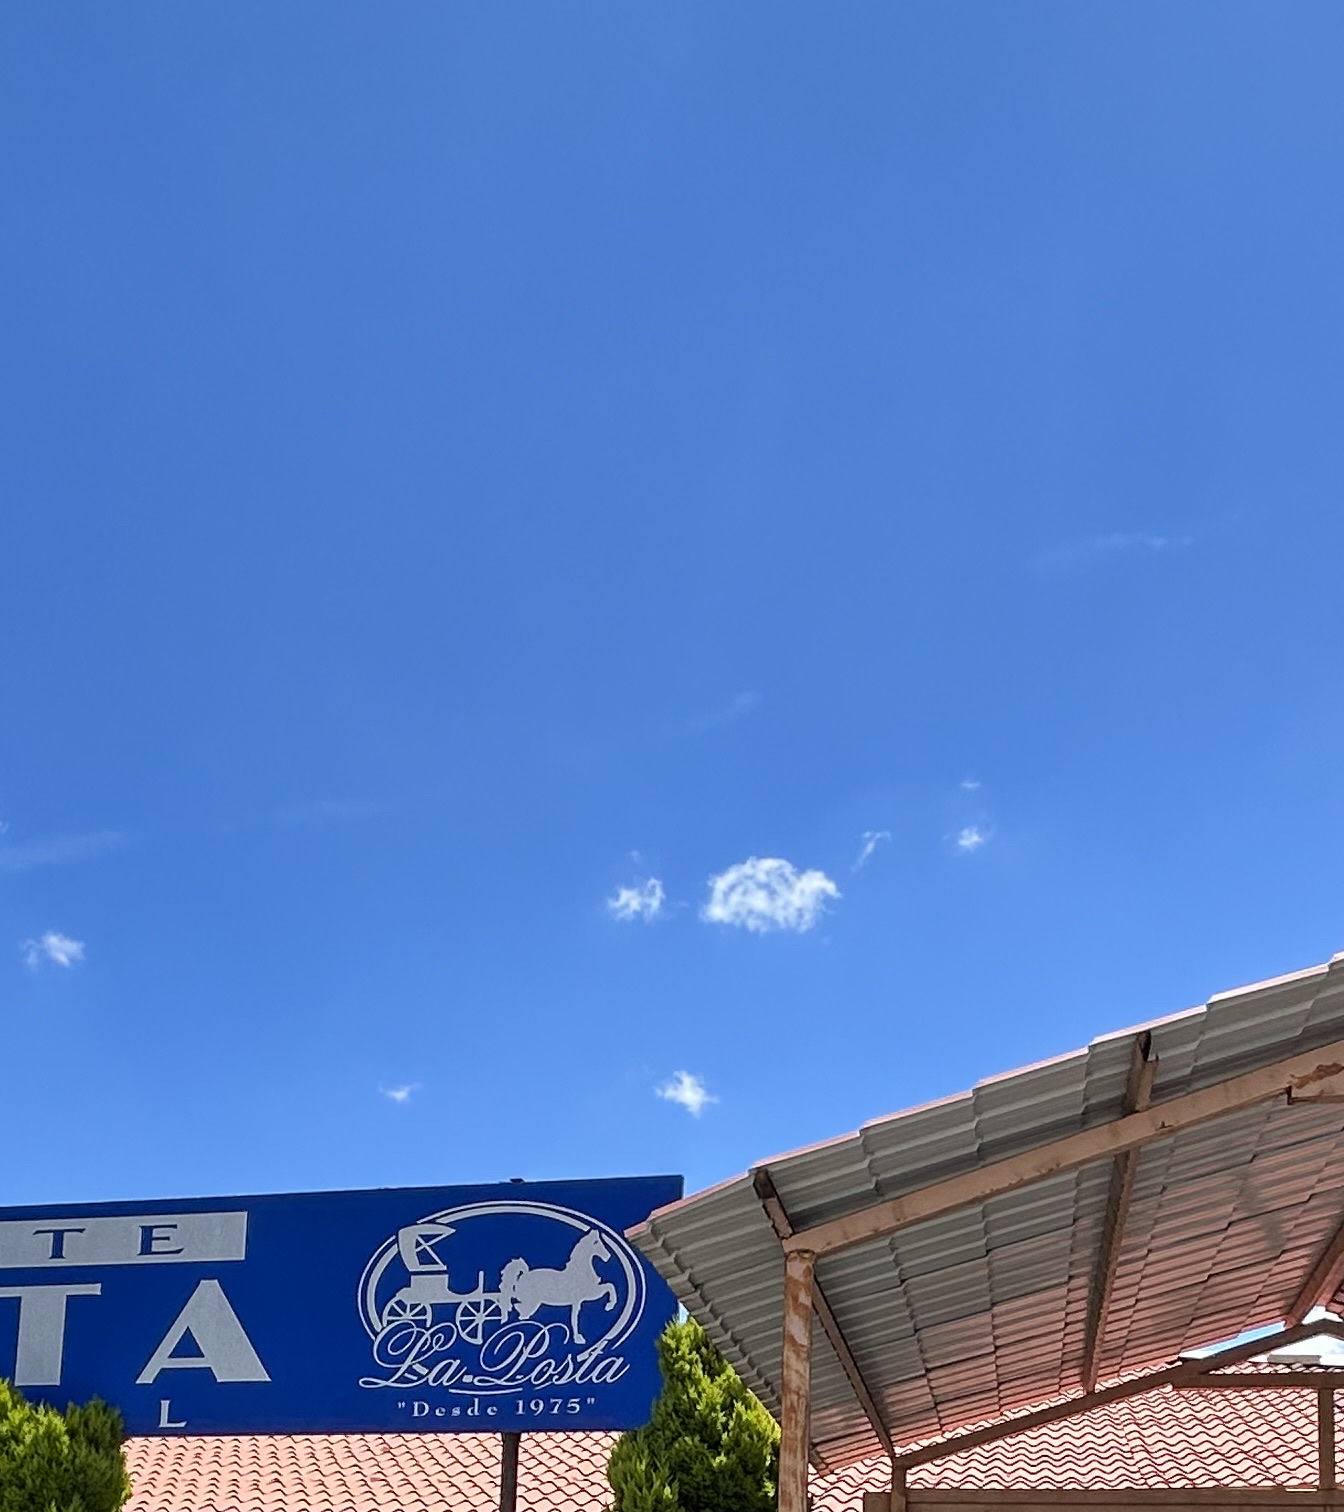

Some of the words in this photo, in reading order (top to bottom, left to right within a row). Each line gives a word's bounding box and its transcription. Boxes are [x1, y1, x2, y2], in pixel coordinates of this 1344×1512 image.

[359, 1320, 467, 1388] La
[473, 1320, 631, 1390] Posta
[397, 1397, 499, 1418] "Desde
[515, 1397, 595, 1415] 1975"
